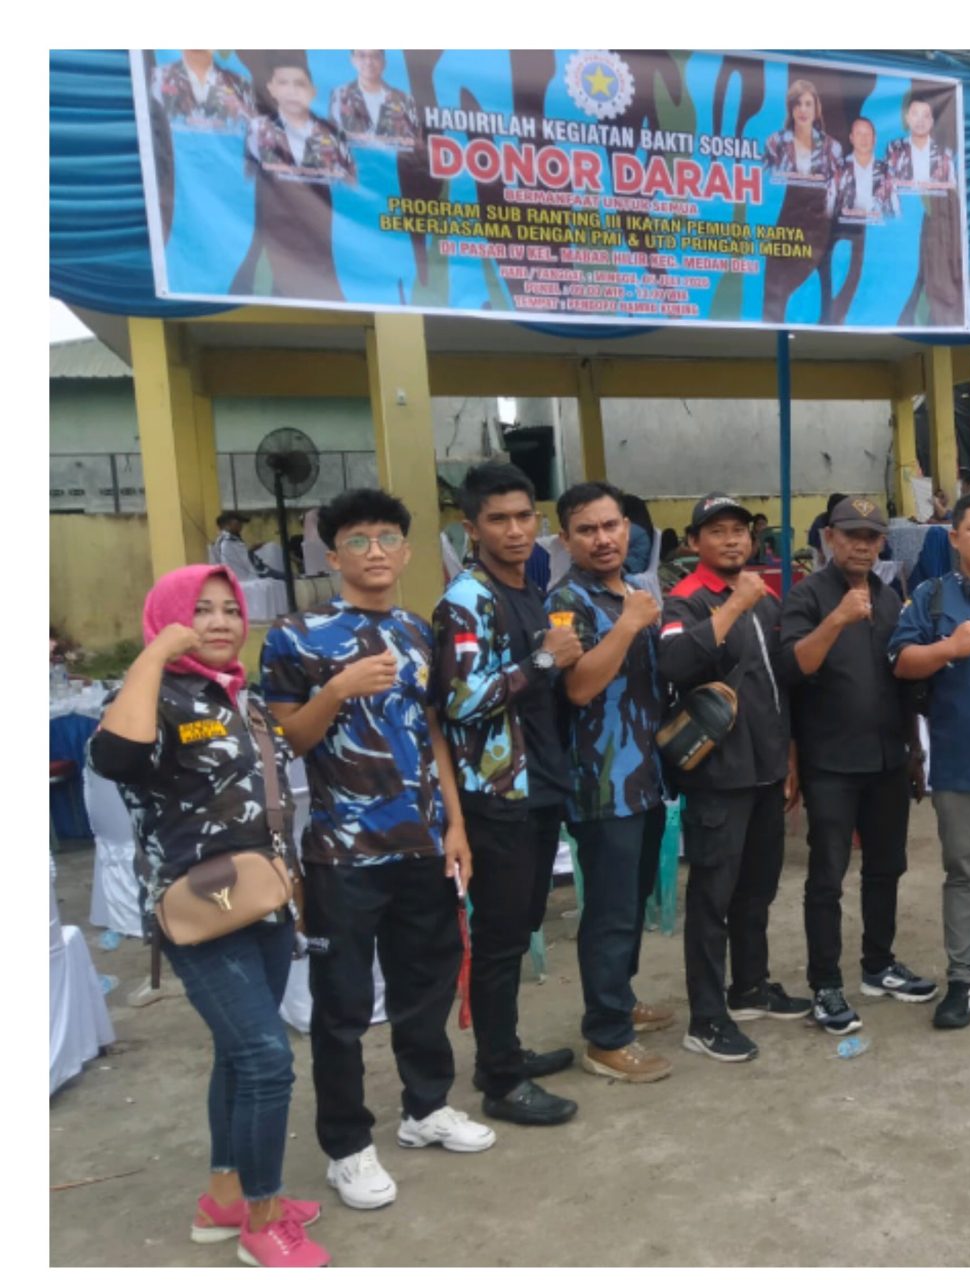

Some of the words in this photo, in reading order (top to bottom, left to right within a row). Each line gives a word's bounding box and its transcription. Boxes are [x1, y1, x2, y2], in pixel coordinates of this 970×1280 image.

[425, 106, 536, 139] HADIRILAH
[542, 118, 634, 148] KEGIATAN
[641, 128, 693, 153] BAKTI
[700, 134, 763, 160] SOSIAL
[428, 134, 602, 191] DONOR
[612, 152, 763, 205] DARAH
[388, 198, 481, 219] PROGRAM
[486, 205, 521, 222] SUB
[527, 208, 599, 228] RANTING
[606, 211, 621, 229] III
[626, 214, 681, 233] IKATAN
[687, 220, 751, 239] PEMUDA
[756, 225, 805, 242] KARYA
[653, 200, 698, 214] SEMUA
[380, 214, 512, 239] BEKERJASAMA
[517, 225, 586, 243] DENGAN
[592, 230, 621, 246] PMI
[628, 233, 640, 247] &
[681, 236, 754, 255] PRINGADI
[760, 242, 813, 259] MEDAN
[439, 240, 456, 255] DI
[459, 241, 507, 259] PASAR
[684, 256, 729, 272] MEDAN
[731, 258, 760, 275] DELI
